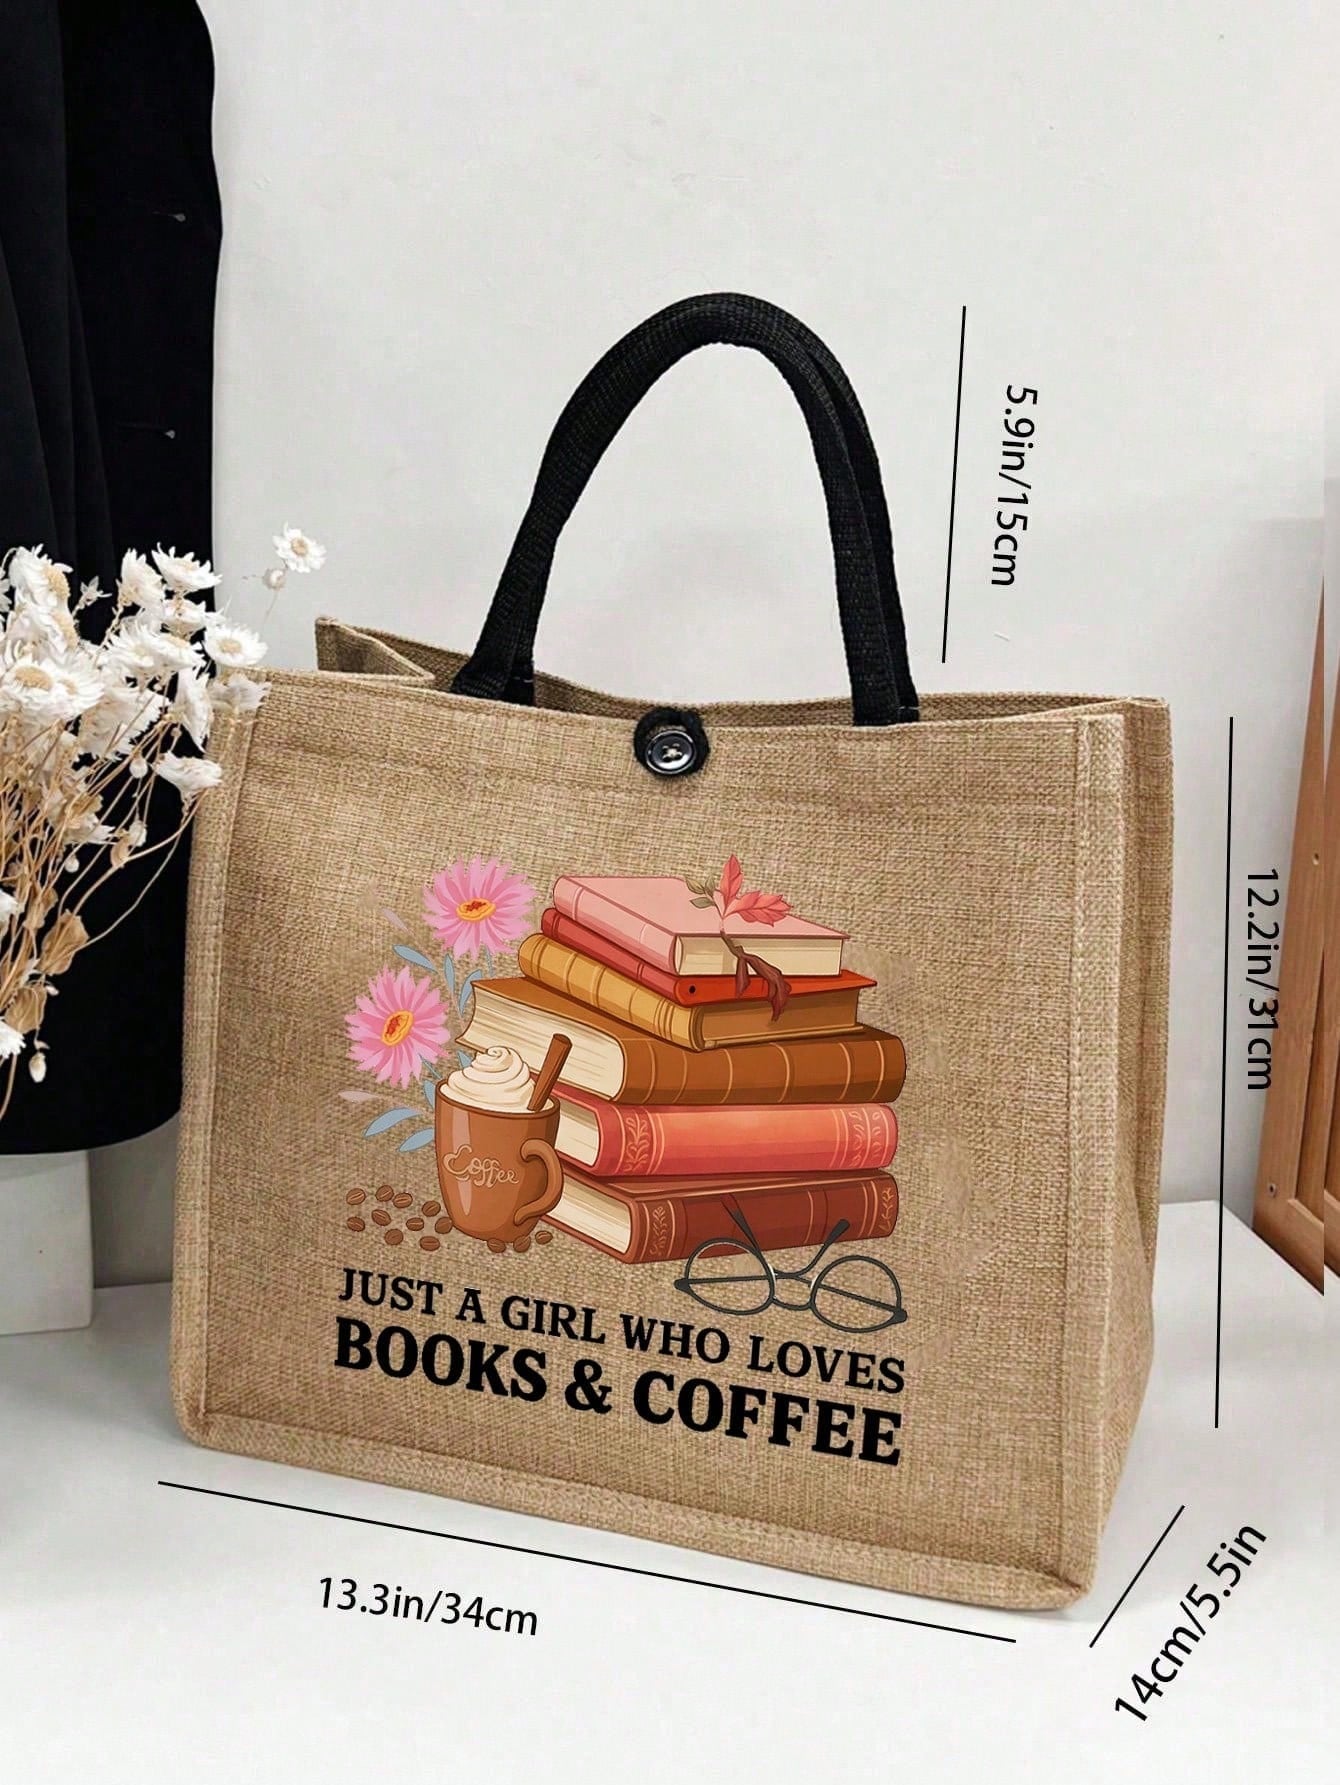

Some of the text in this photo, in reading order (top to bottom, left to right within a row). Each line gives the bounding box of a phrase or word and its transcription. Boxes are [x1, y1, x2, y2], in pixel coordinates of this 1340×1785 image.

[443, 1144, 520, 1188] Coffee
[334, 1315, 902, 1467] BOOKS & COFFEE
[338, 1267, 905, 1394] JUST A GIRL WHO LOVES
